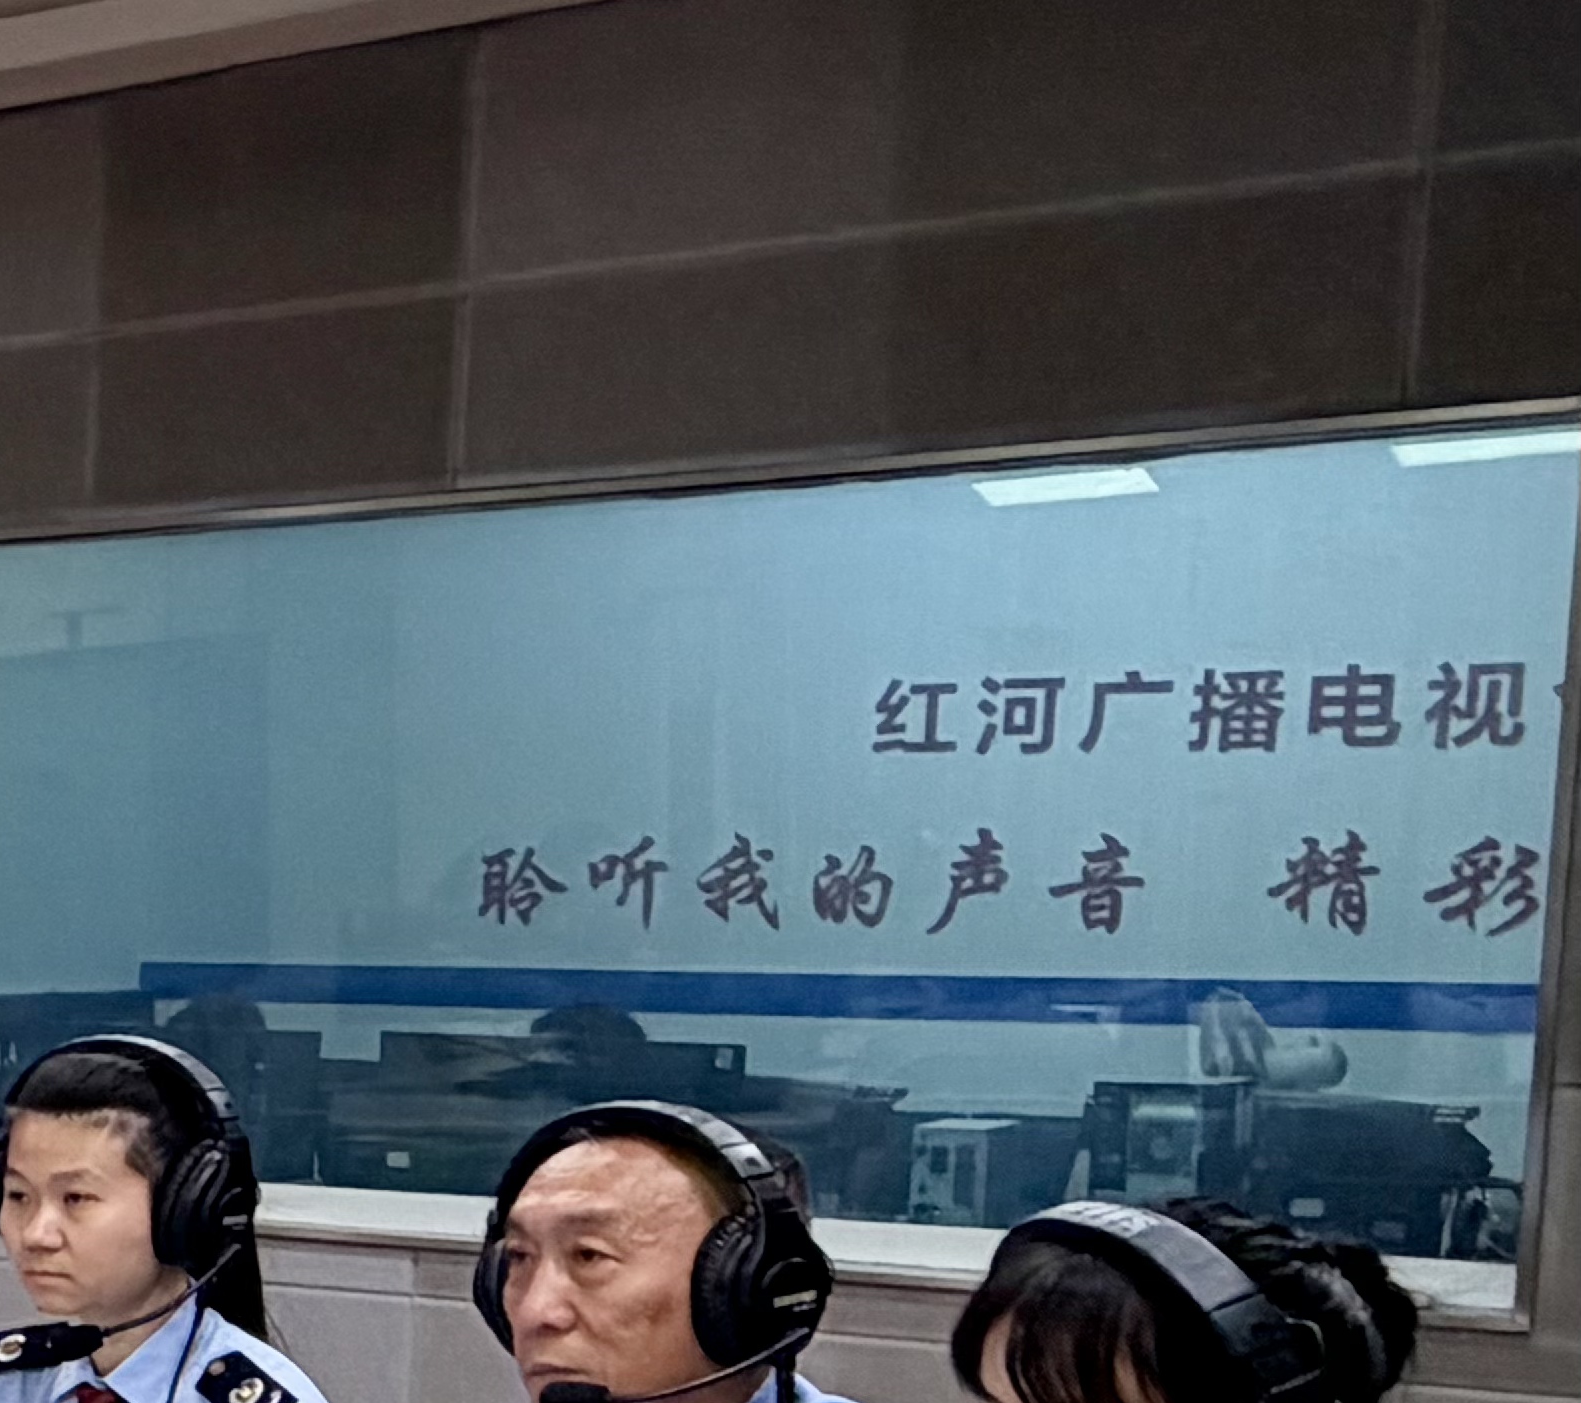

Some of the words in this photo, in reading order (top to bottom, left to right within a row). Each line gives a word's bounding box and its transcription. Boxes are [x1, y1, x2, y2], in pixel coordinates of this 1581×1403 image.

[871, 661, 1563, 755] 红河广播电视
[477, 825, 1147, 937] 聆听我的声音
[1265, 828, 1541, 938] 精彩
